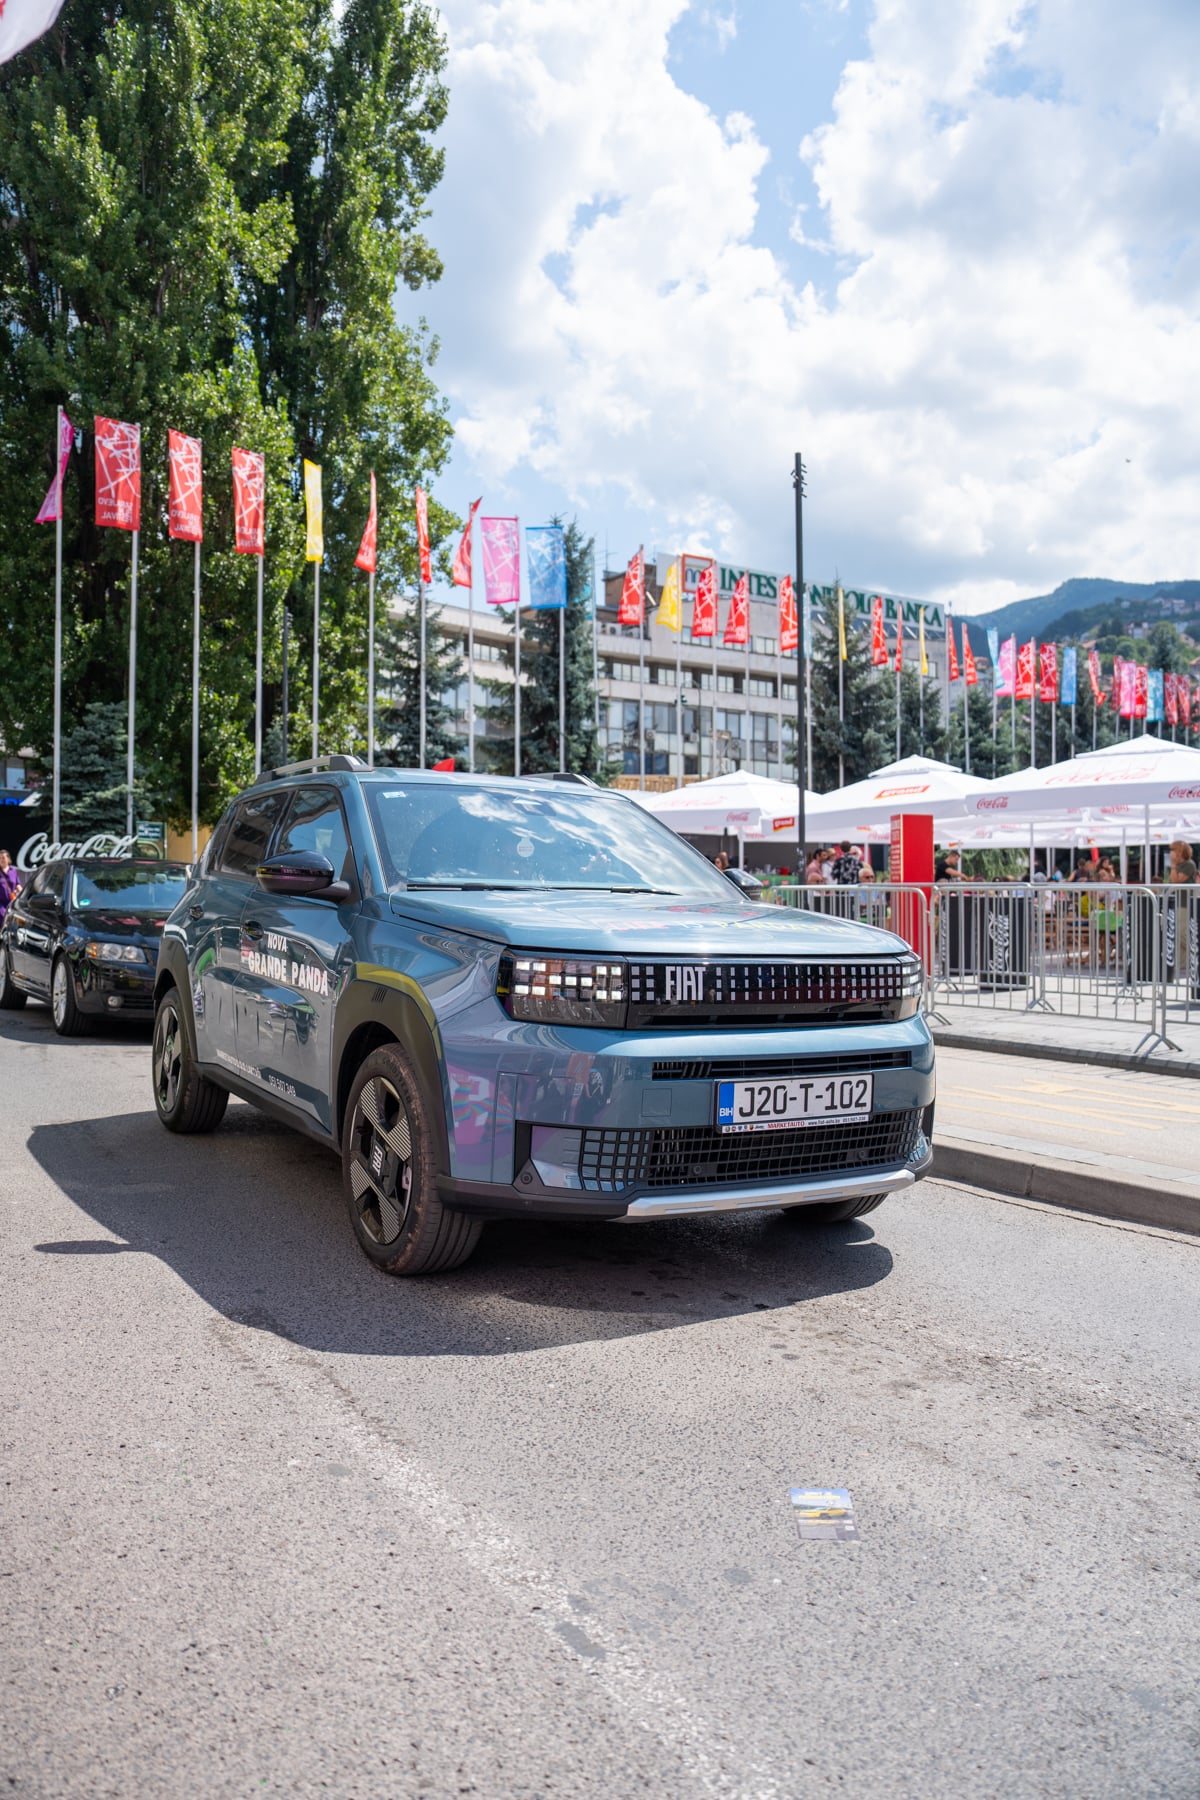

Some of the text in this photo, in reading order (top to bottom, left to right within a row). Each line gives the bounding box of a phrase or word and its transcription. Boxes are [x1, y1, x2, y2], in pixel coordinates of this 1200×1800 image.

[720, 567, 778, 598] INTES
[885, 597, 942, 627] BANKA
[16, 832, 139, 872] Coca-Cl
[267, 934, 287, 953] NOVA
[248, 950, 329, 997] GRANDE PANDA
[665, 966, 706, 1001] FIAT
[719, 1107, 733, 1117] BIH
[739, 1079, 868, 1118] J20-T-102
[372, 1146, 383, 1177] FIAT
